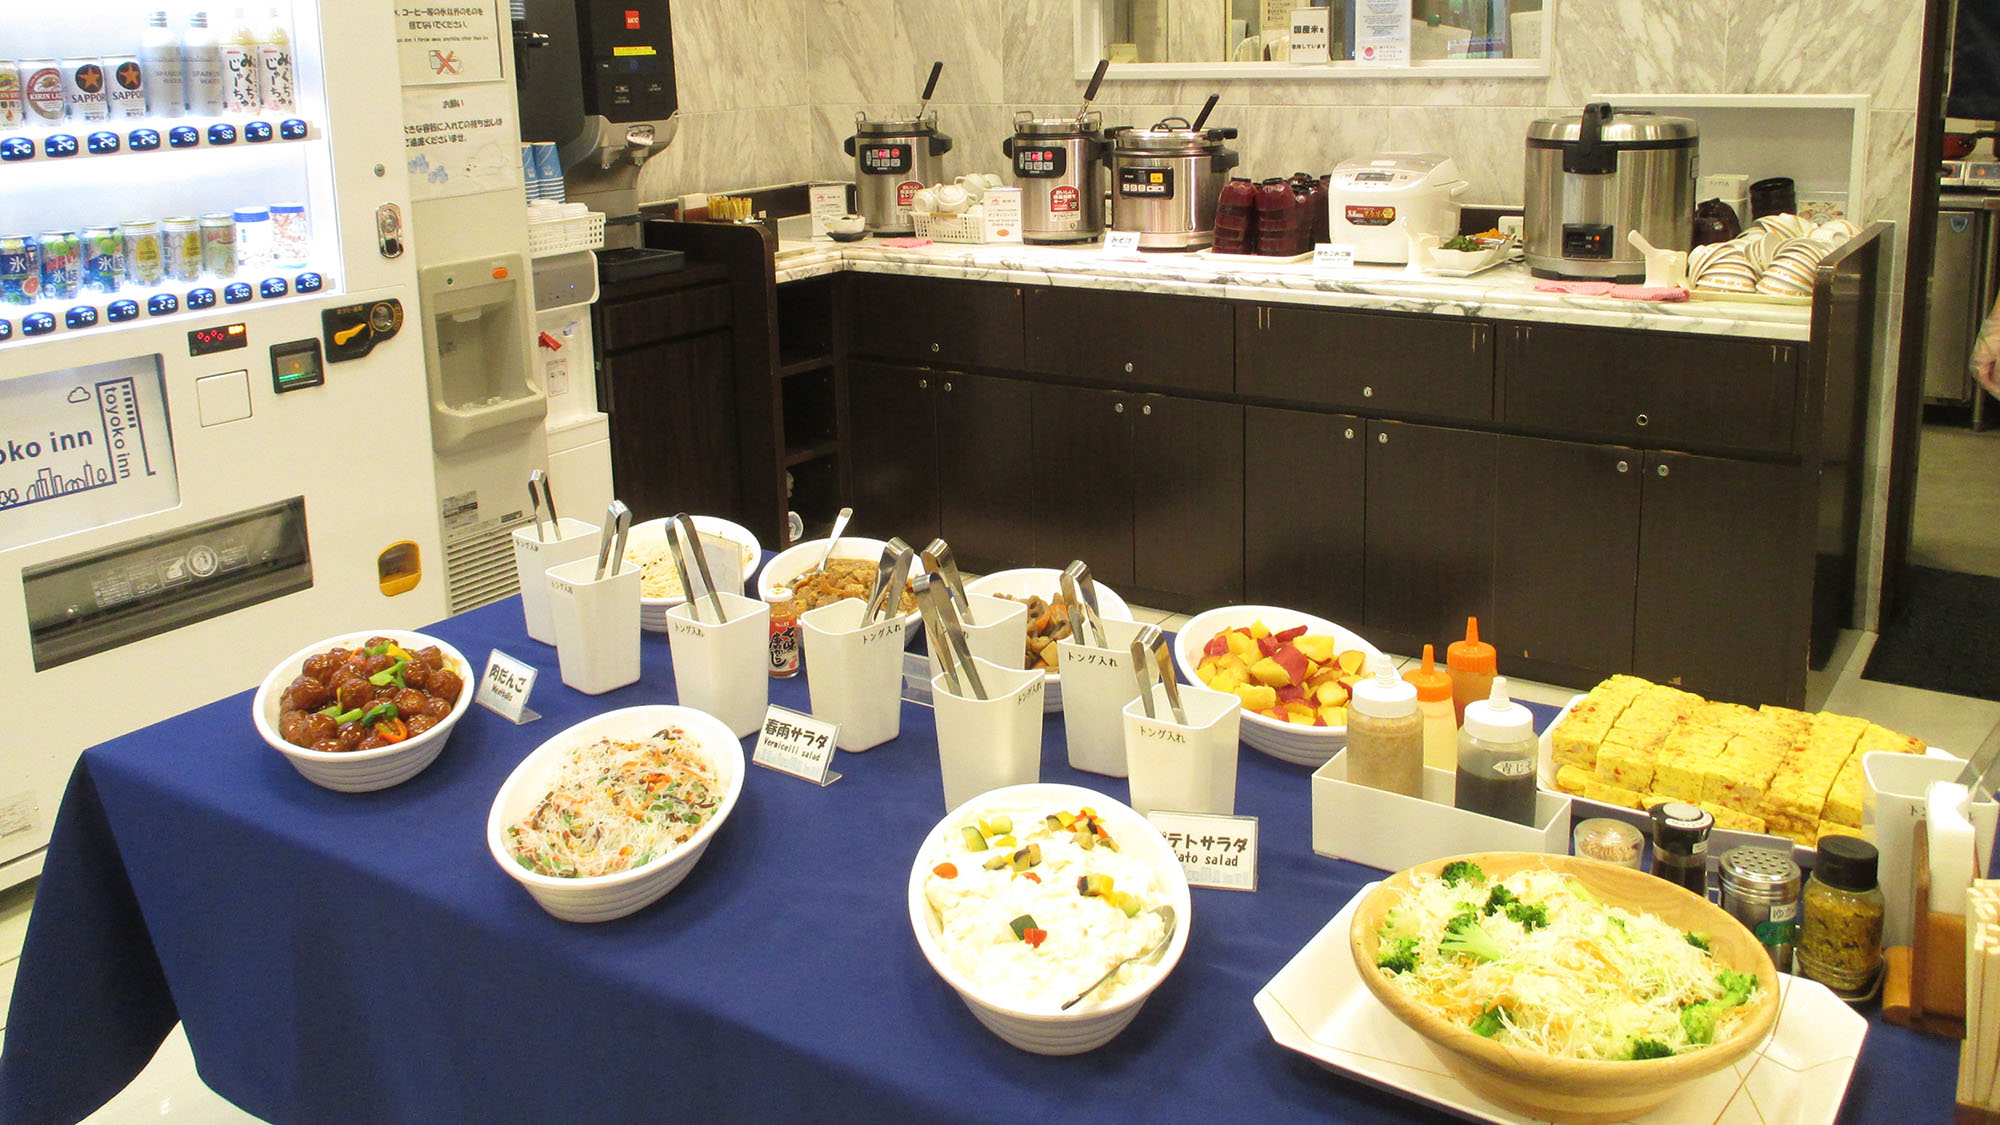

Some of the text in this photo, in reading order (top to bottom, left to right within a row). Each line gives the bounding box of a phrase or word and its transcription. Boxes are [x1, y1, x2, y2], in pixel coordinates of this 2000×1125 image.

[1293, 25, 1324, 34] 国産米を
[72, 93, 105, 104] SAPPOR
[112, 90, 143, 100] SAPPO
[50, 430, 93, 452] inn
[104, 386, 131, 479] toyoko inn
[863, 624, 901, 644] トング入れ
[1067, 651, 1118, 668] トング入れ
[489, 664, 527, 693] 肉だんご
[1018, 682, 1042, 705] トング入れ
[765, 718, 829, 749] 春雨サラダ
[1140, 725, 1186, 744] トング入れ
[764, 736, 821, 761] Vermicelli salad
[1160, 831, 1248, 853] テトサラダ
[1204, 854, 1239, 867] salad
